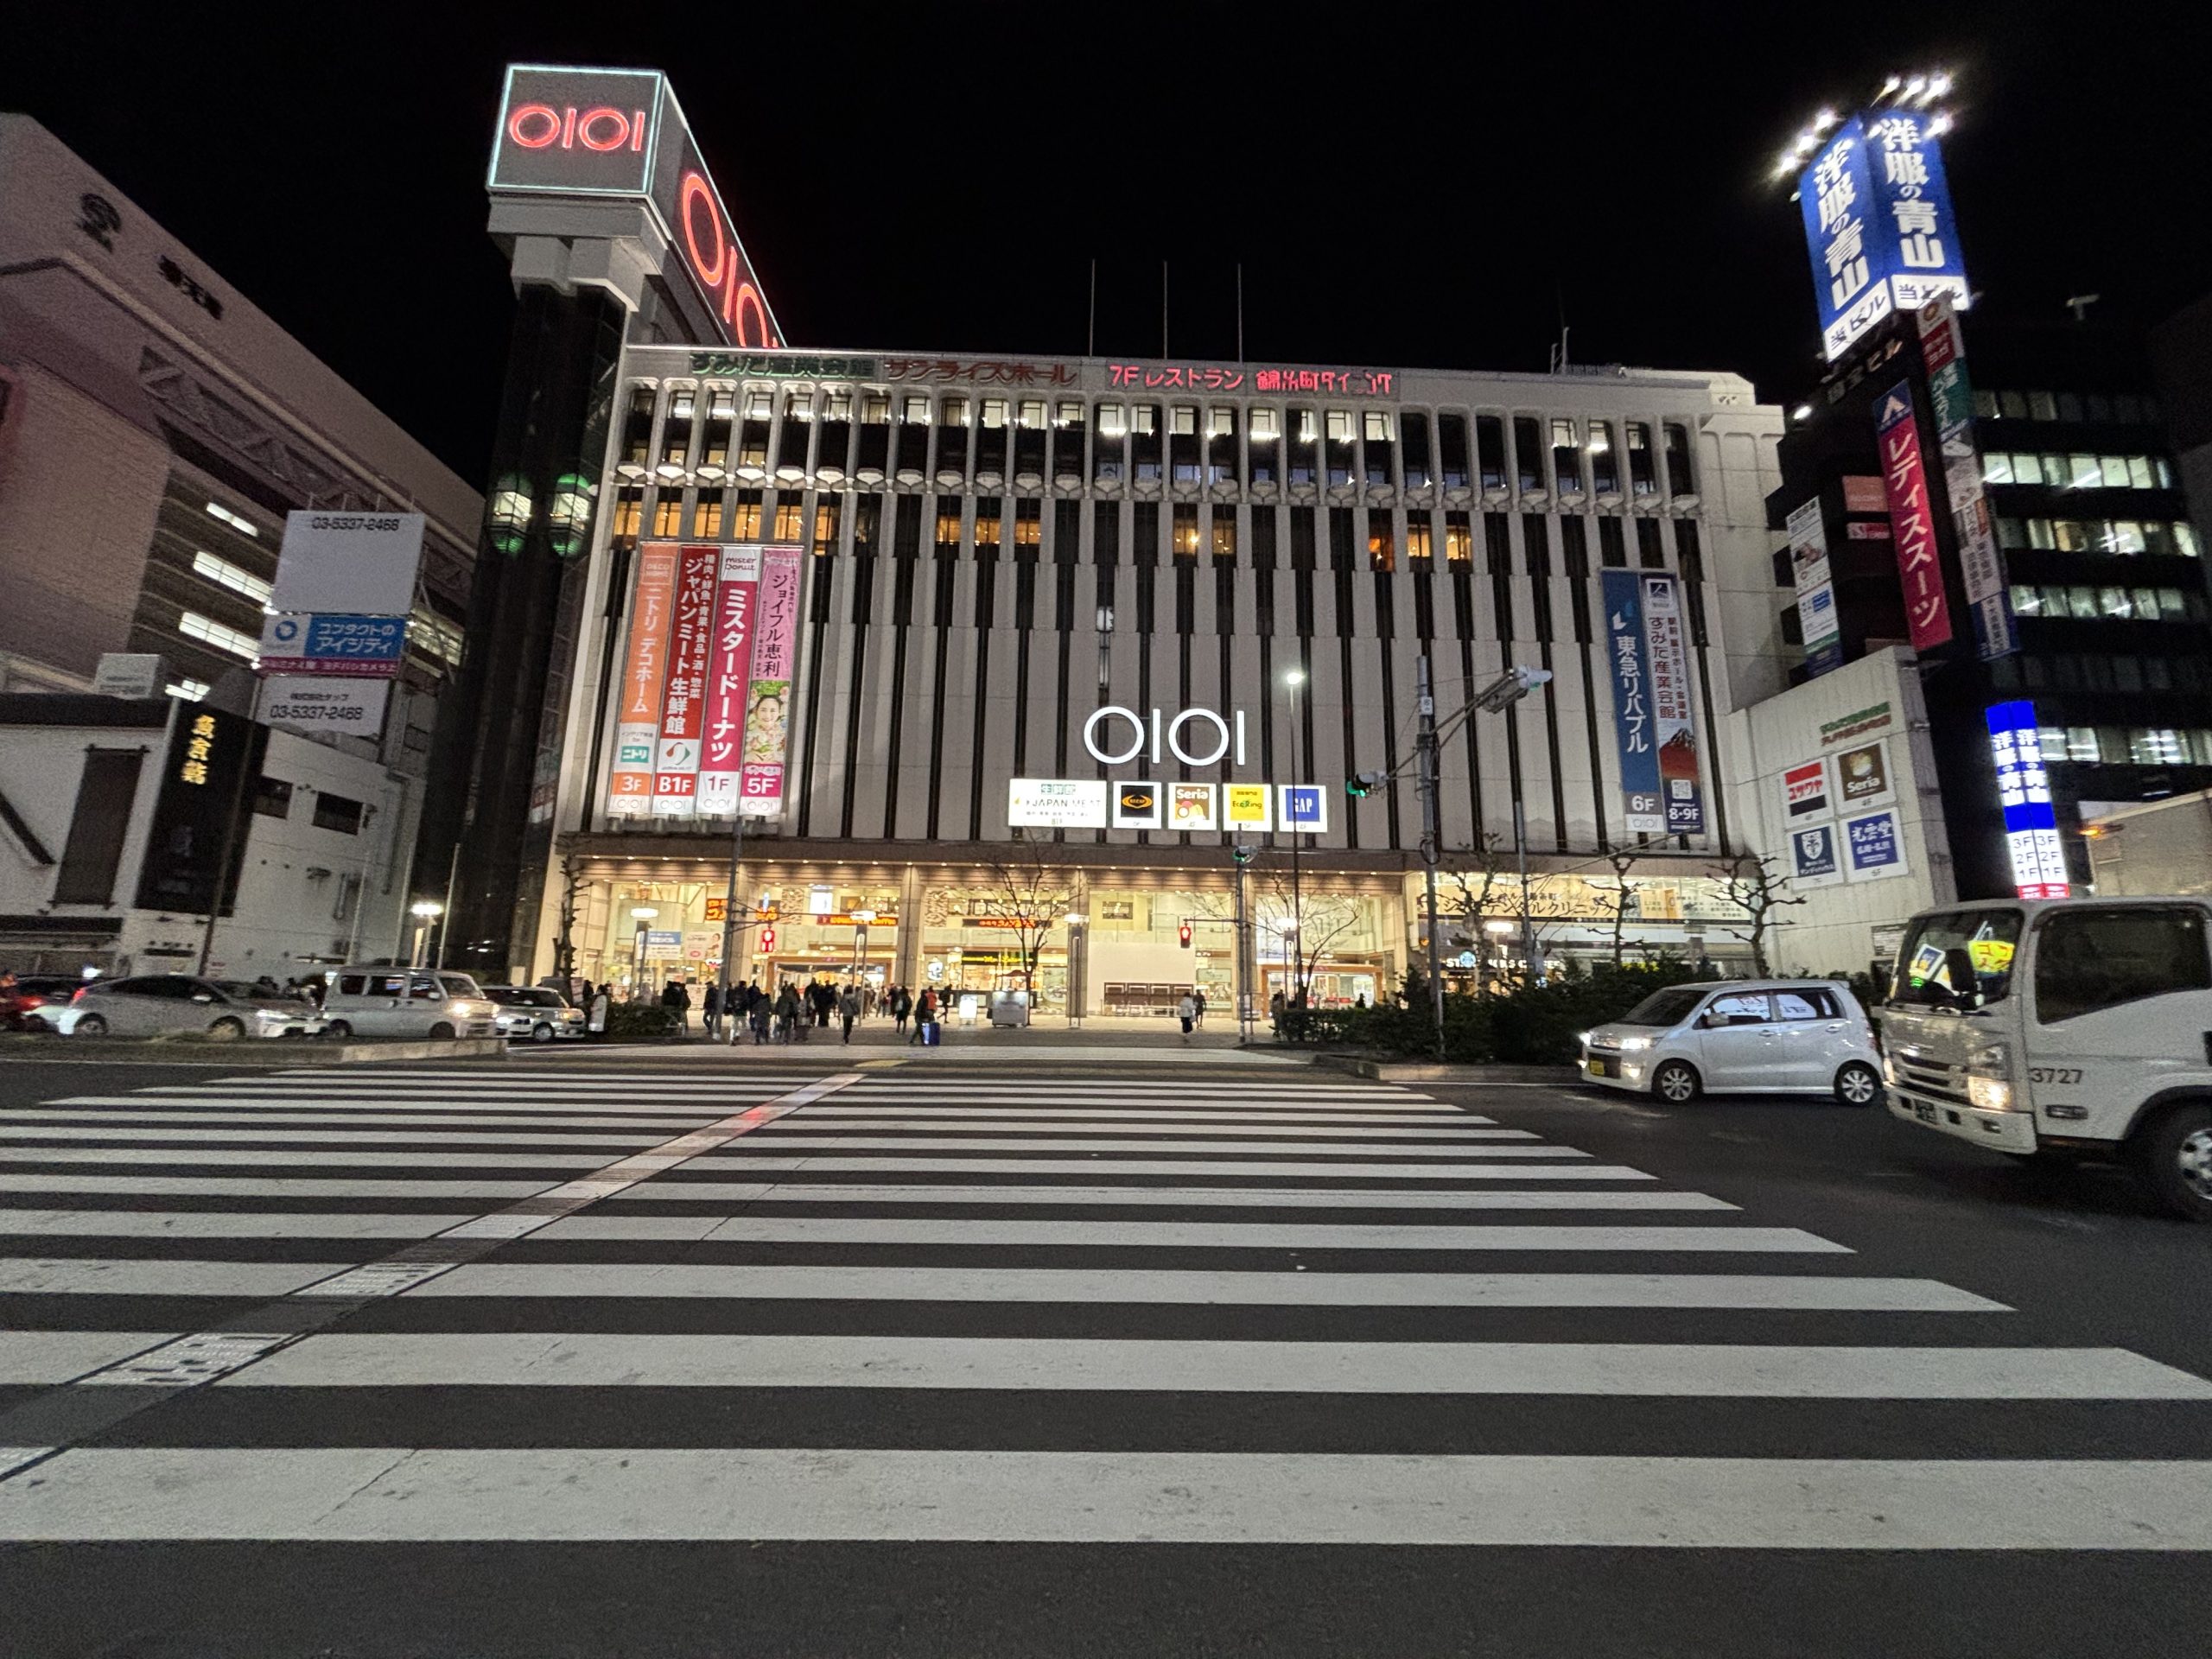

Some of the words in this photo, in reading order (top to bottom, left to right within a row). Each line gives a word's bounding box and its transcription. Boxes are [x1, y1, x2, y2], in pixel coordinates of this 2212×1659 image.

[1813, 137, 1870, 311] 洋服の青山
[884, 359, 1078, 385] サンライズホール
[1109, 365, 1139, 387] 7F
[1145, 368, 1243, 390] レストラン
[312, 518, 399, 531] 03-5337-2468
[1888, 433, 1940, 629] レディススーツ
[643, 588, 663, 632] ニトリ
[317, 623, 396, 636] コンタクトの
[763, 574, 788, 677] ジョイフル恵利
[315, 637, 392, 653] アイシティ
[664, 557, 704, 734] ジャパンミート生鮮館
[632, 637, 658, 713] デコホーム
[711, 588, 747, 762] ミスタードーナツ
[1616, 636, 1649, 753] 東急リバブル
[270, 705, 363, 720] 03-5337-2468
[621, 749, 649, 761] ニトリ
[621, 775, 643, 792] 3F
[658, 776, 692, 793] B1F
[708, 776, 730, 791] 1F
[747, 778, 777, 794] 5F
[1847, 776, 1880, 794] Seria
[1176, 788, 1209, 799] Seria
[1631, 795, 1655, 811] 6F
[2012, 836, 2032, 848] 3F
[2037, 836, 2057, 846] 3F
[2015, 852, 2035, 864] 2F
[2039, 851, 2060, 861] 2F
[2019, 868, 2038, 879] 1F
[2043, 867, 2063, 877] 1F
[2031, 1068, 2083, 1084] 3727
